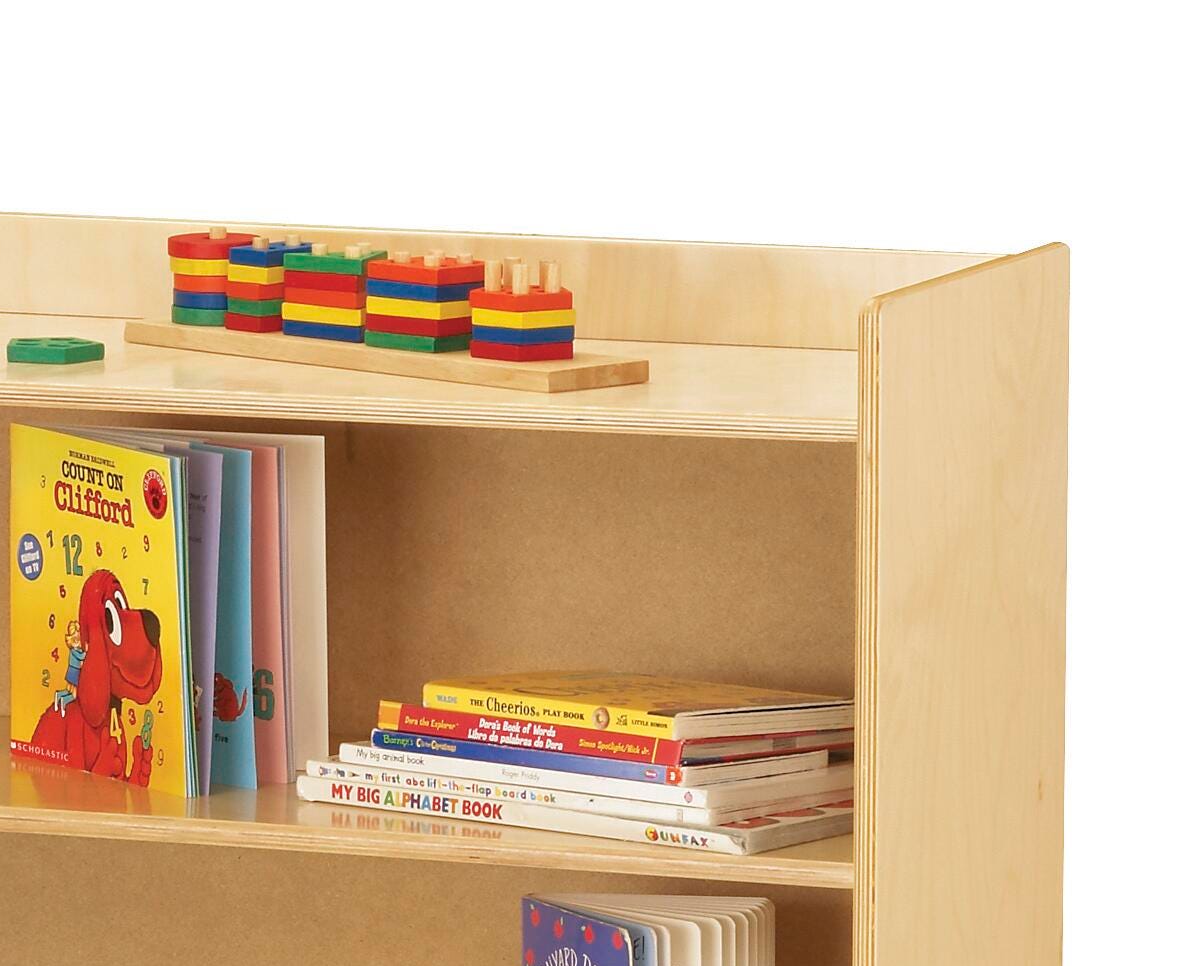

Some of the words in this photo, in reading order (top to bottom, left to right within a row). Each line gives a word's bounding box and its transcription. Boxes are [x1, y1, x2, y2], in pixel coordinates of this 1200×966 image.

[61, 460, 104, 487] COUNT
[106, 472, 123, 492] ON
[143, 469, 168, 497] CLIFFORD
[54, 480, 135, 528] Clifford
[62, 534, 84, 577] 12
[143, 535, 150, 552] 9
[142, 578, 149, 596] 7
[253, 668, 276, 721] 6
[470, 698, 484, 708] THE
[486, 696, 538, 717] Cheerios
[543, 709, 560, 718] PLAY
[563, 711, 585, 721] BOOK
[109, 707, 122, 745] 4
[479, 718, 501, 731] Dora's
[502, 721, 521, 734] Book
[522, 723, 532, 734] of
[532, 724, 556, 737] Words
[16, 742, 70, 763] SCHOLASTIC
[356, 748, 368, 758] My
[370, 750, 380, 761] big
[382, 753, 405, 763] animal
[407, 755, 425, 765] book
[331, 783, 353, 800] MY
[357, 786, 380, 804] BIG
[383, 790, 459, 814] ALPHABET
[462, 799, 503, 820] BOOK
[381, 773, 401, 784] first
[405, 777, 425, 787] abc
[494, 787, 527, 800] board
[530, 791, 556, 803] book
